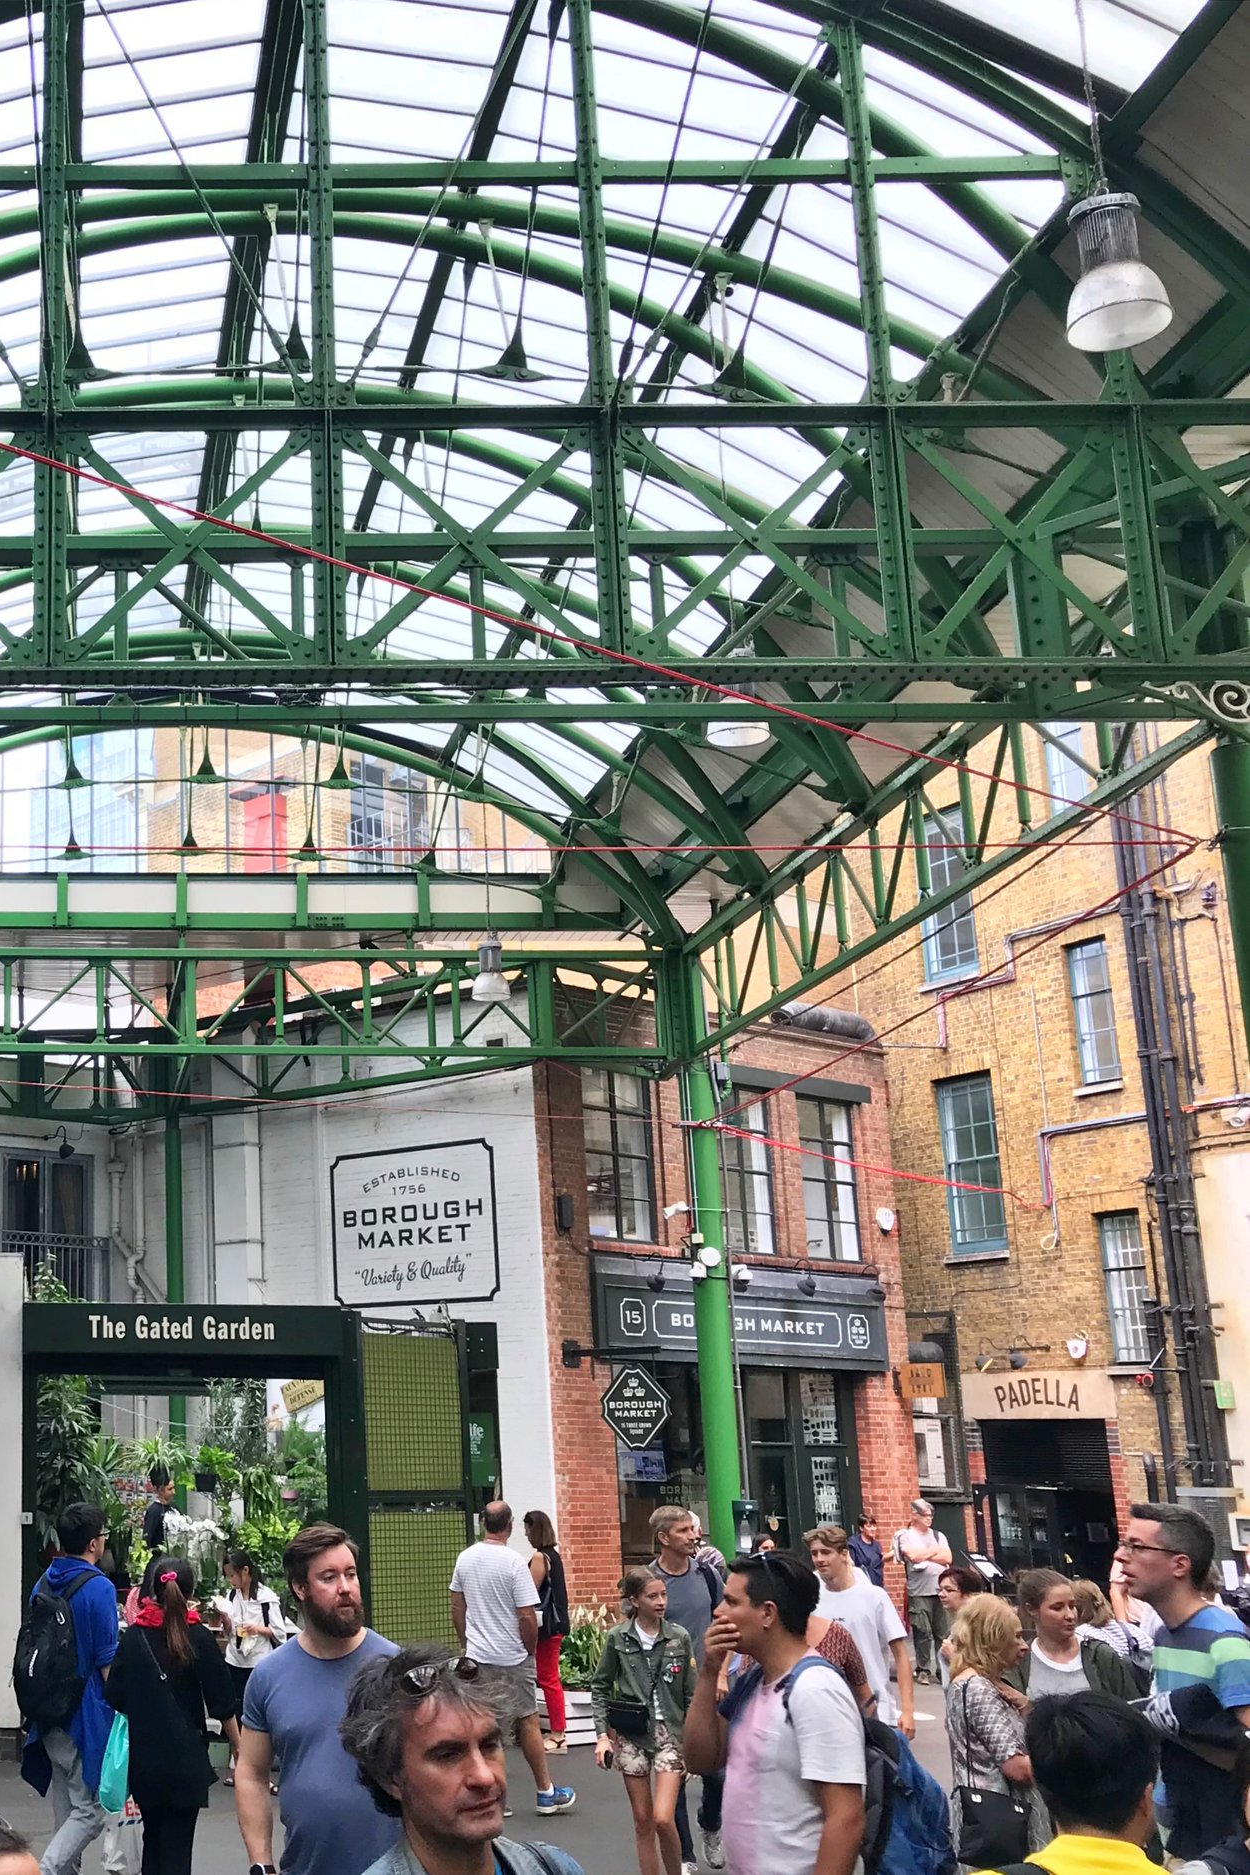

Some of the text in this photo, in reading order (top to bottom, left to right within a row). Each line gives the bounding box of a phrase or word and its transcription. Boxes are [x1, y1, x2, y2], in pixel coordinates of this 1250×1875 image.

[362, 1166, 461, 1194] ESTABLISHED
[391, 1183, 426, 1196] 1756
[343, 1197, 483, 1228] BOROUGH
[358, 1223, 471, 1250] MARKET
[406, 1261, 417, 1282] &
[88, 1314, 276, 1340] The Gated Garden
[624, 1310, 642, 1325] 15
[670, 1313, 825, 1336] BOGH MARKET
[609, 1400, 662, 1409] BOROUGH
[994, 1377, 1080, 1412] PADELLA
[614, 1409, 657, 1418] MARKET
